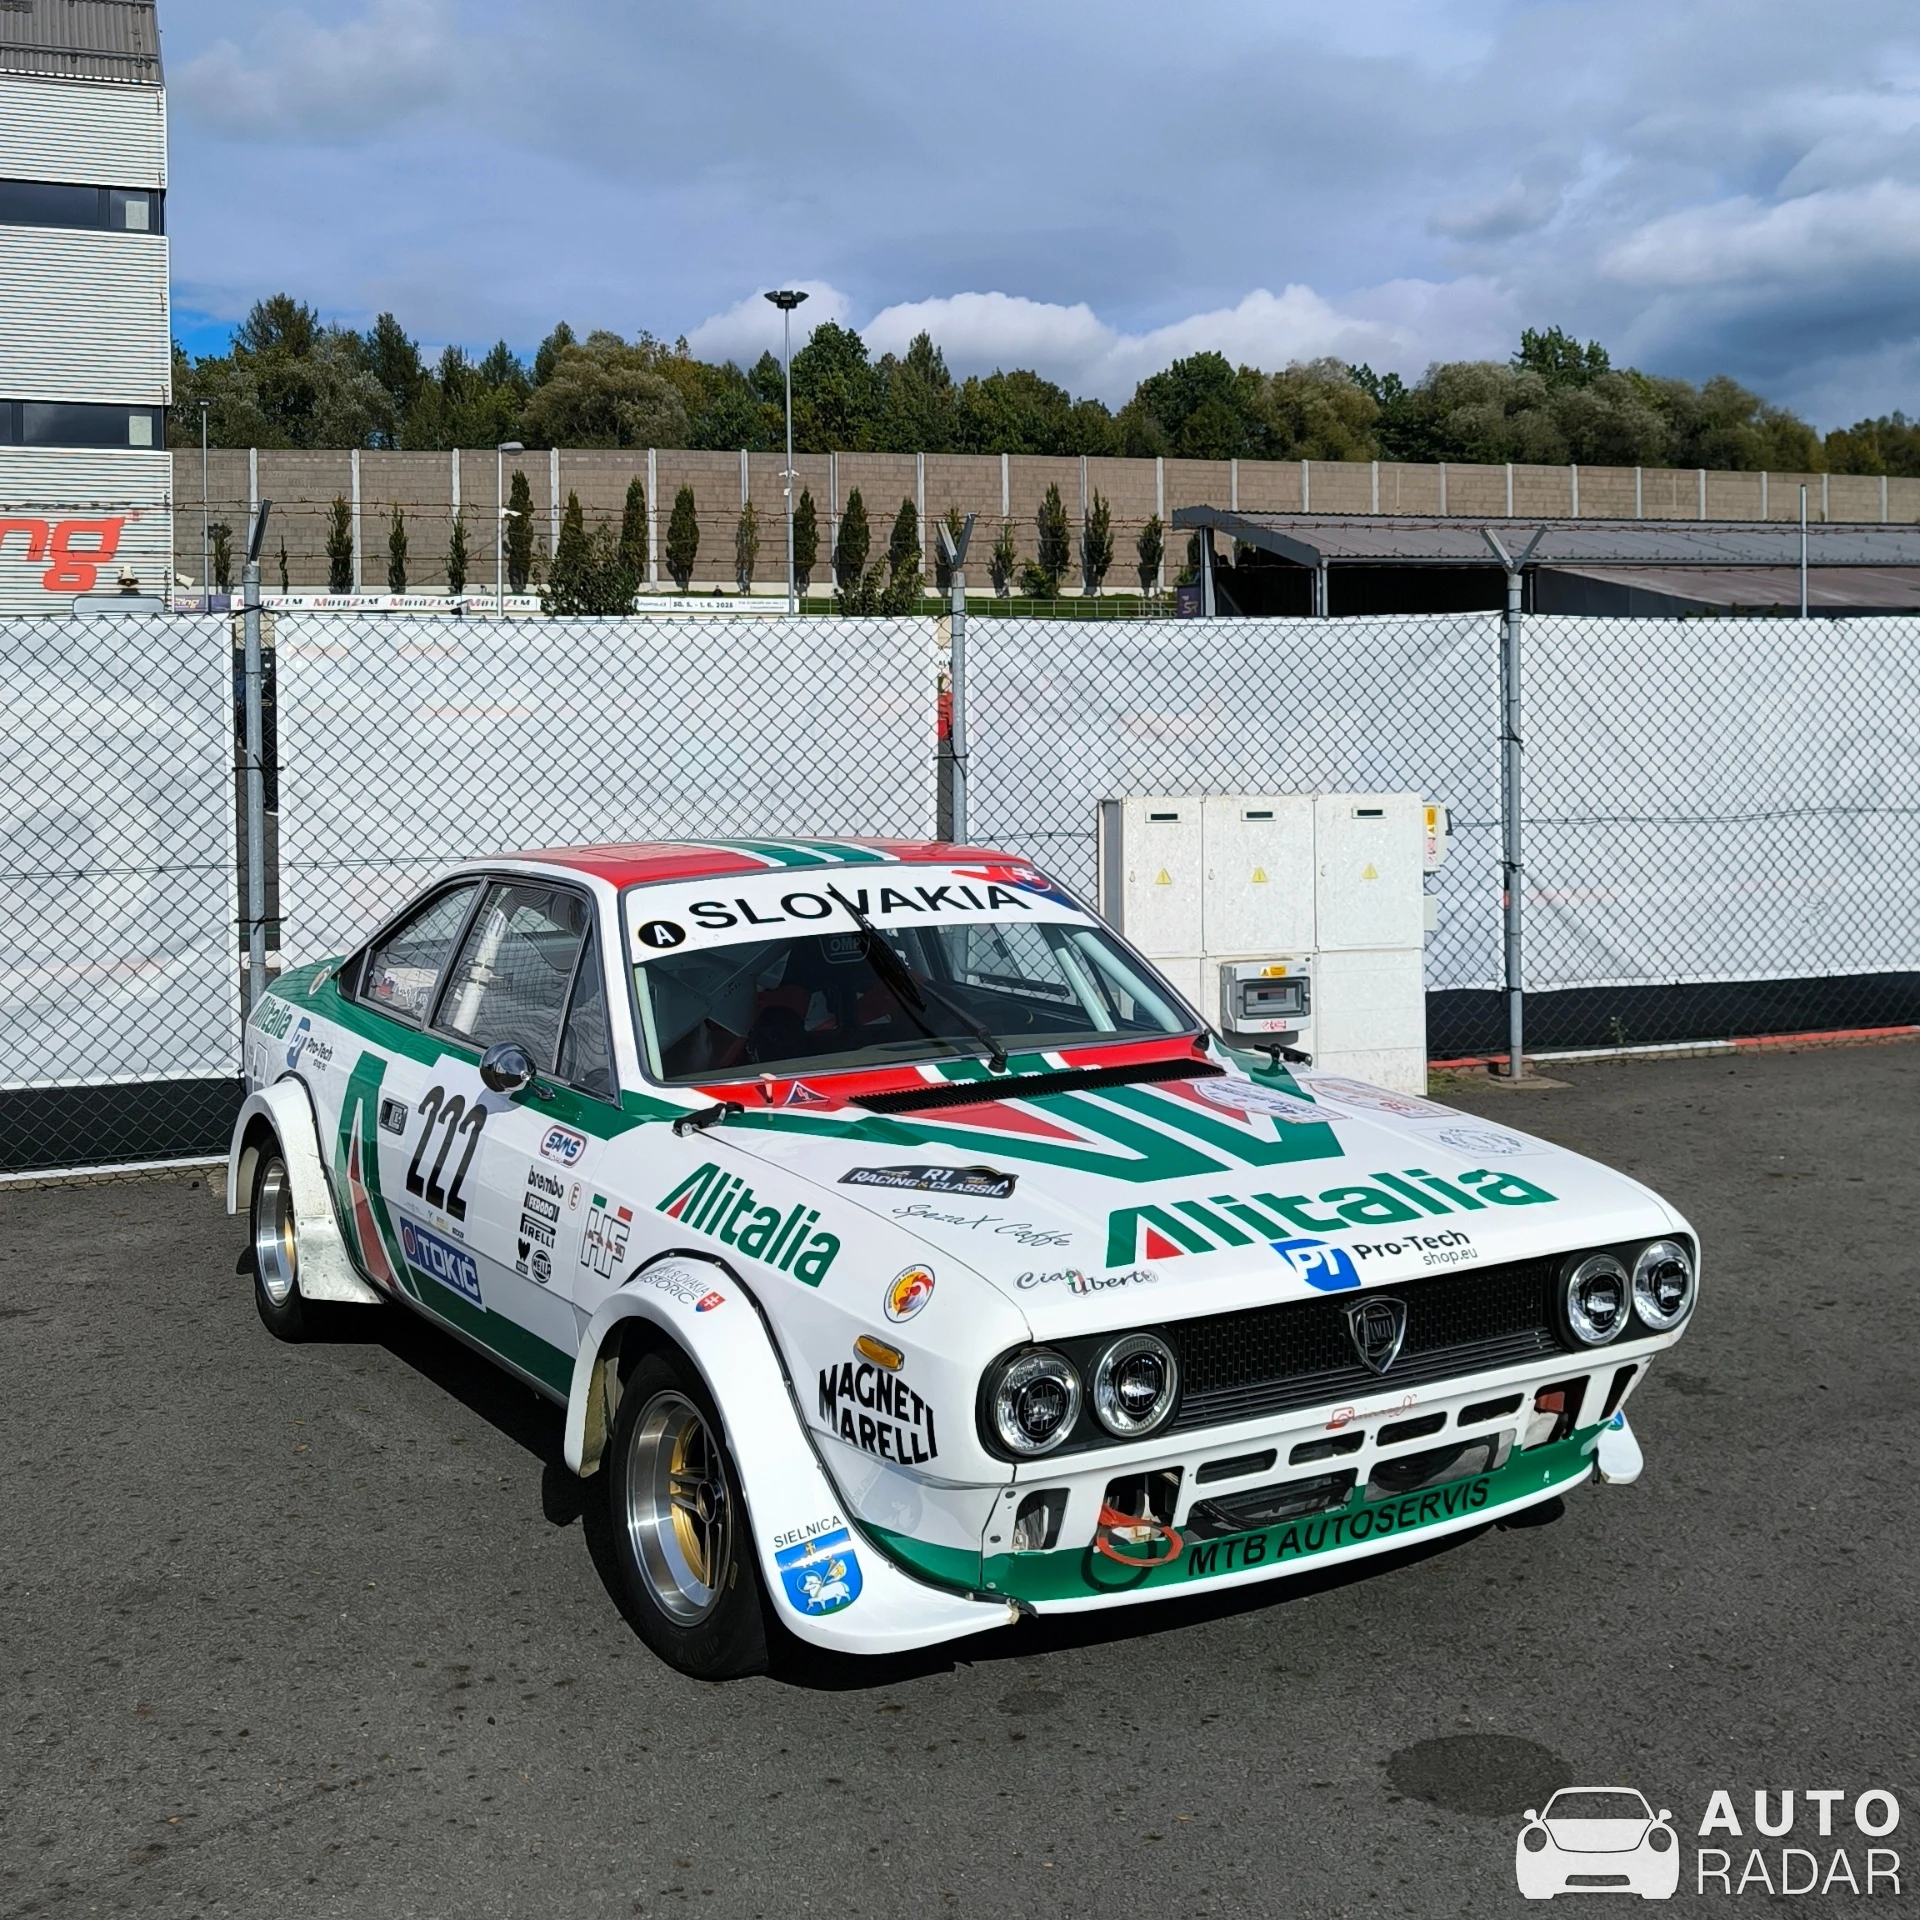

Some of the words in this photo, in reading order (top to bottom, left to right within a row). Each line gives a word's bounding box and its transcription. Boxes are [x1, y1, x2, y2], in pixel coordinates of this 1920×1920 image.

[653, 924, 676, 945] A
[688, 886, 1033, 929] SLOVAKIA
[248, 995, 293, 1040] Alitalia
[406, 1085, 488, 1222] 222
[527, 1165, 564, 1199] brembo
[850, 1170, 920, 1188] RACING
[929, 1179, 1009, 1196] CLASSIC
[921, 1168, 955, 1181] R1
[528, 1195, 555, 1219] FERODO
[655, 1162, 841, 1288] Alitalia
[1106, 1168, 1560, 1269] Alitalia
[520, 1212, 556, 1249] PIRELLI
[1352, 1230, 1470, 1260] Pro-Tech
[1422, 1247, 1478, 1266] shop.eu
[819, 1362, 935, 1430] MAGNETI
[819, 1398, 938, 1465] MARELLI
[773, 1515, 842, 1549] SIELNICA
[1188, 1533, 1267, 1576] MTB
[1277, 1478, 1491, 1559] AUTOSERVIS
